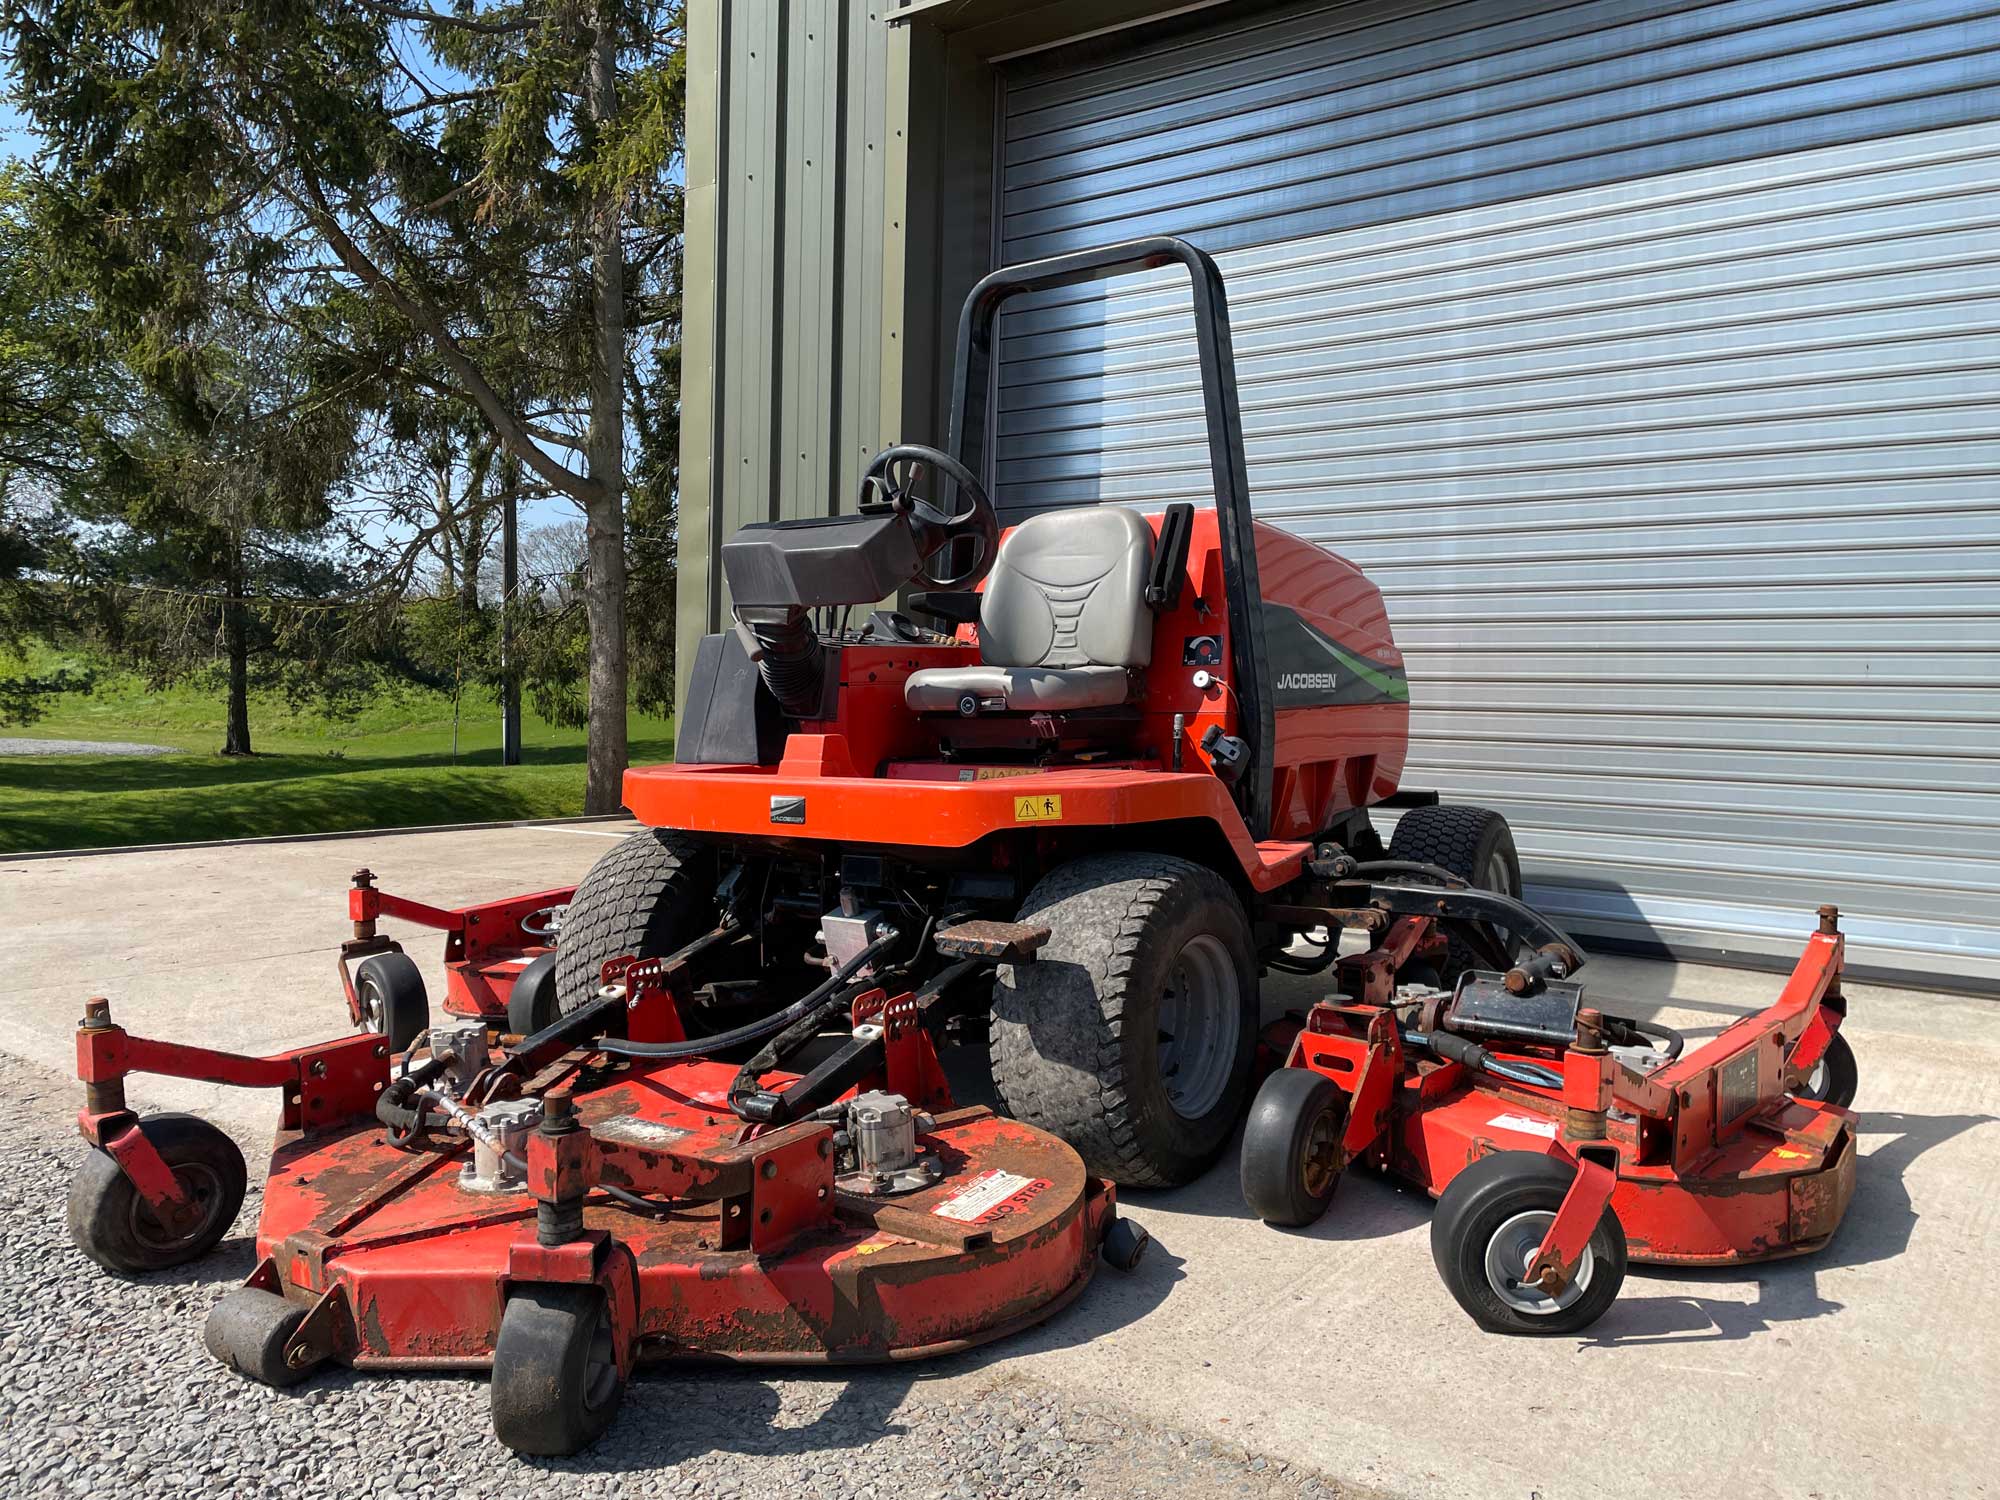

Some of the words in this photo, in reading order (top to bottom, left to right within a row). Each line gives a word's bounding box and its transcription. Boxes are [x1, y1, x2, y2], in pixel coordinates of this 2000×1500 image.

[1277, 673, 1336, 689] JACOBSEN
[983, 1204, 1015, 1222] NO
[1013, 1182, 1047, 1205] STEP
